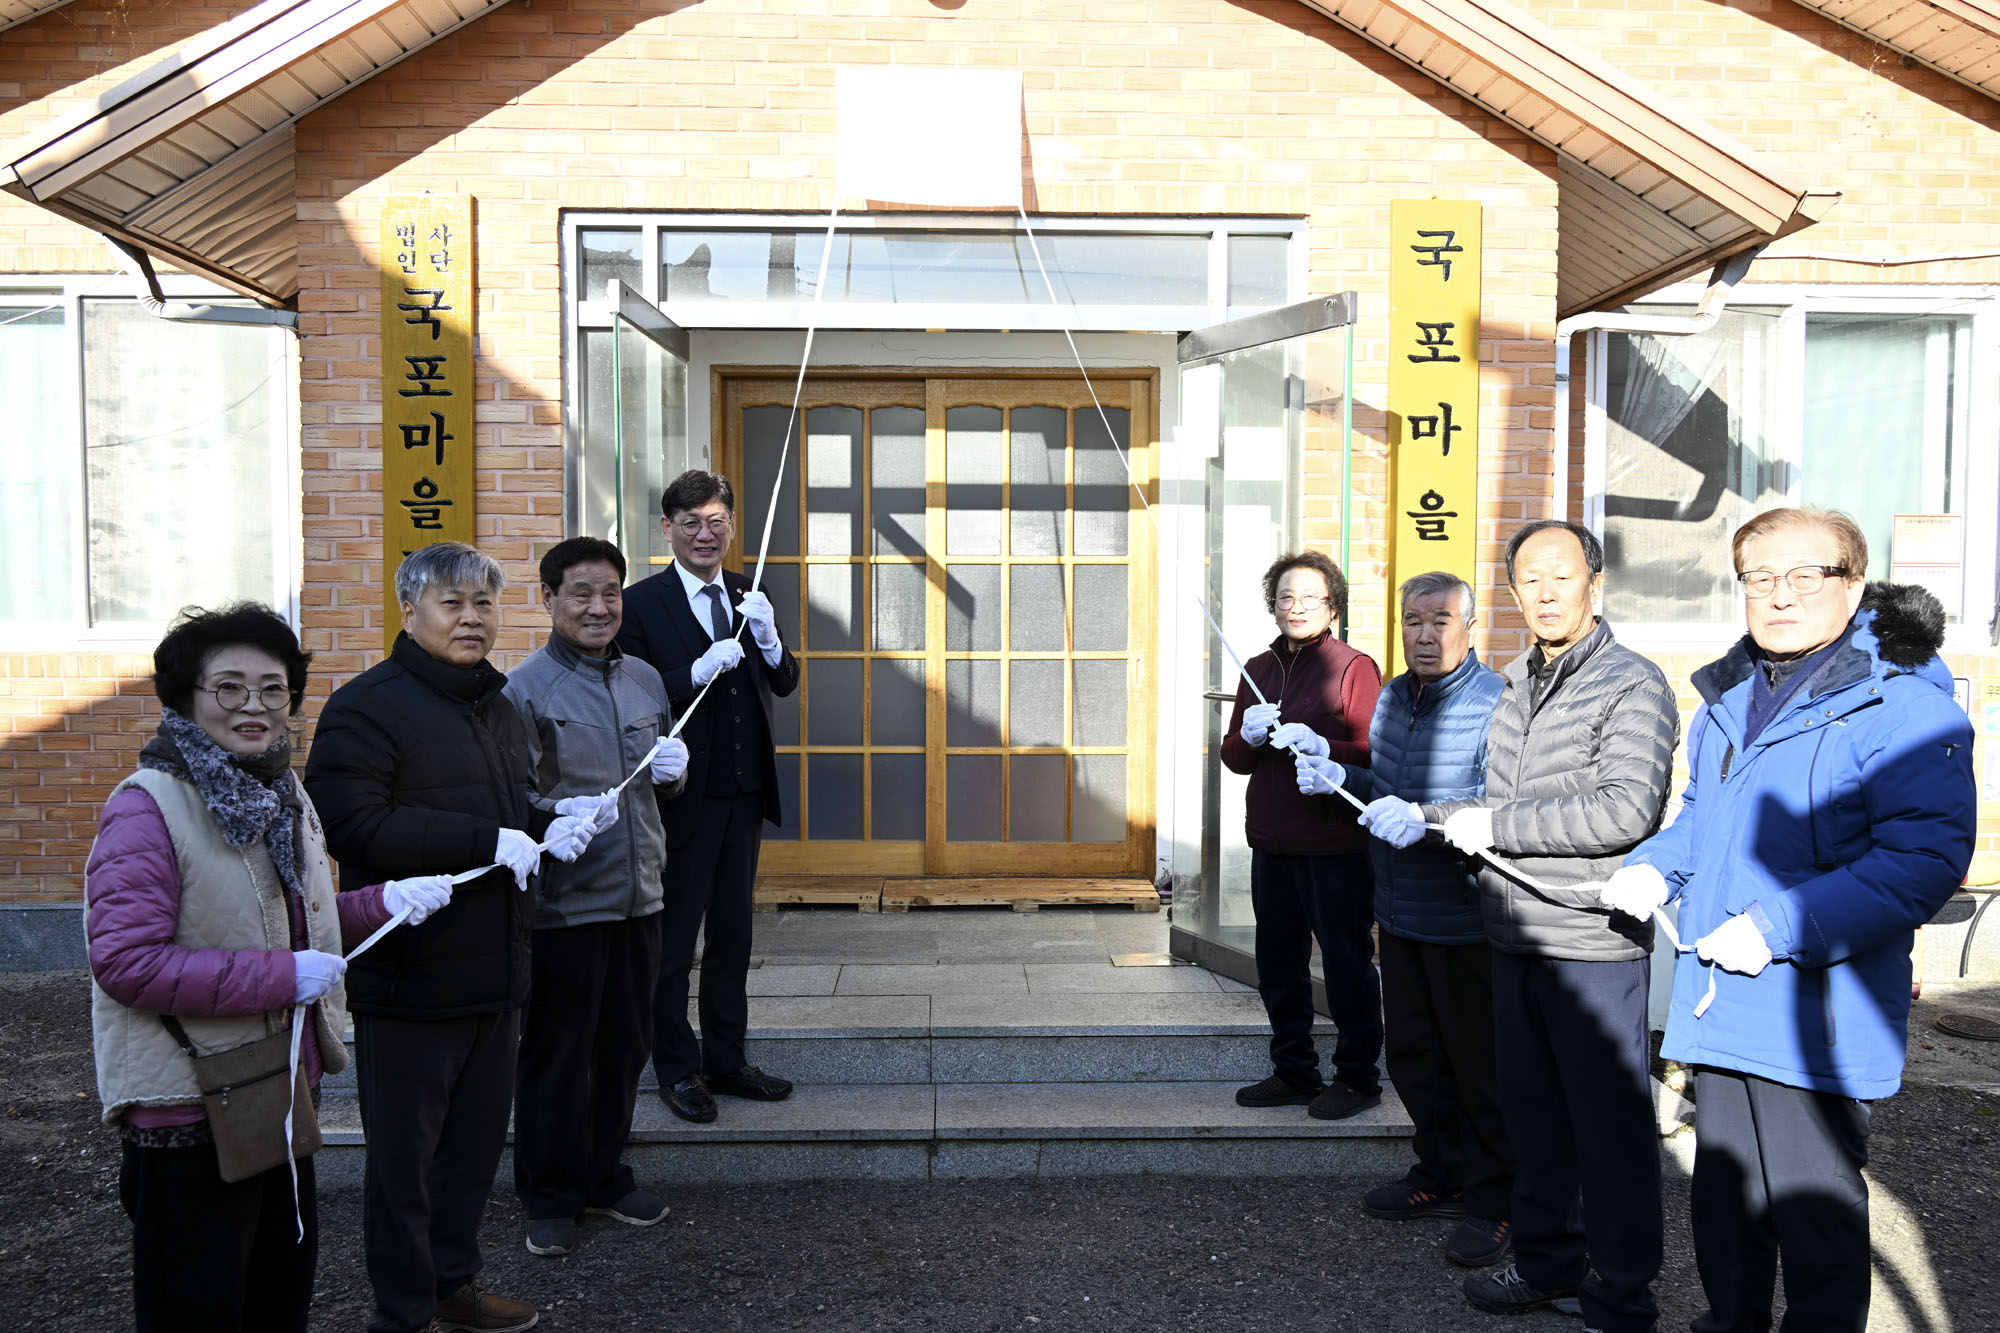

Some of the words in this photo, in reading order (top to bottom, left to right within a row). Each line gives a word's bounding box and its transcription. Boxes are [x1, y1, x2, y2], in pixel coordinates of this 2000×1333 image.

[396, 222, 417, 274] 법인
[428, 223, 453, 273] 사단
[397, 287, 454, 556] 국포마을
[1406, 230, 1464, 541] 국포마을
